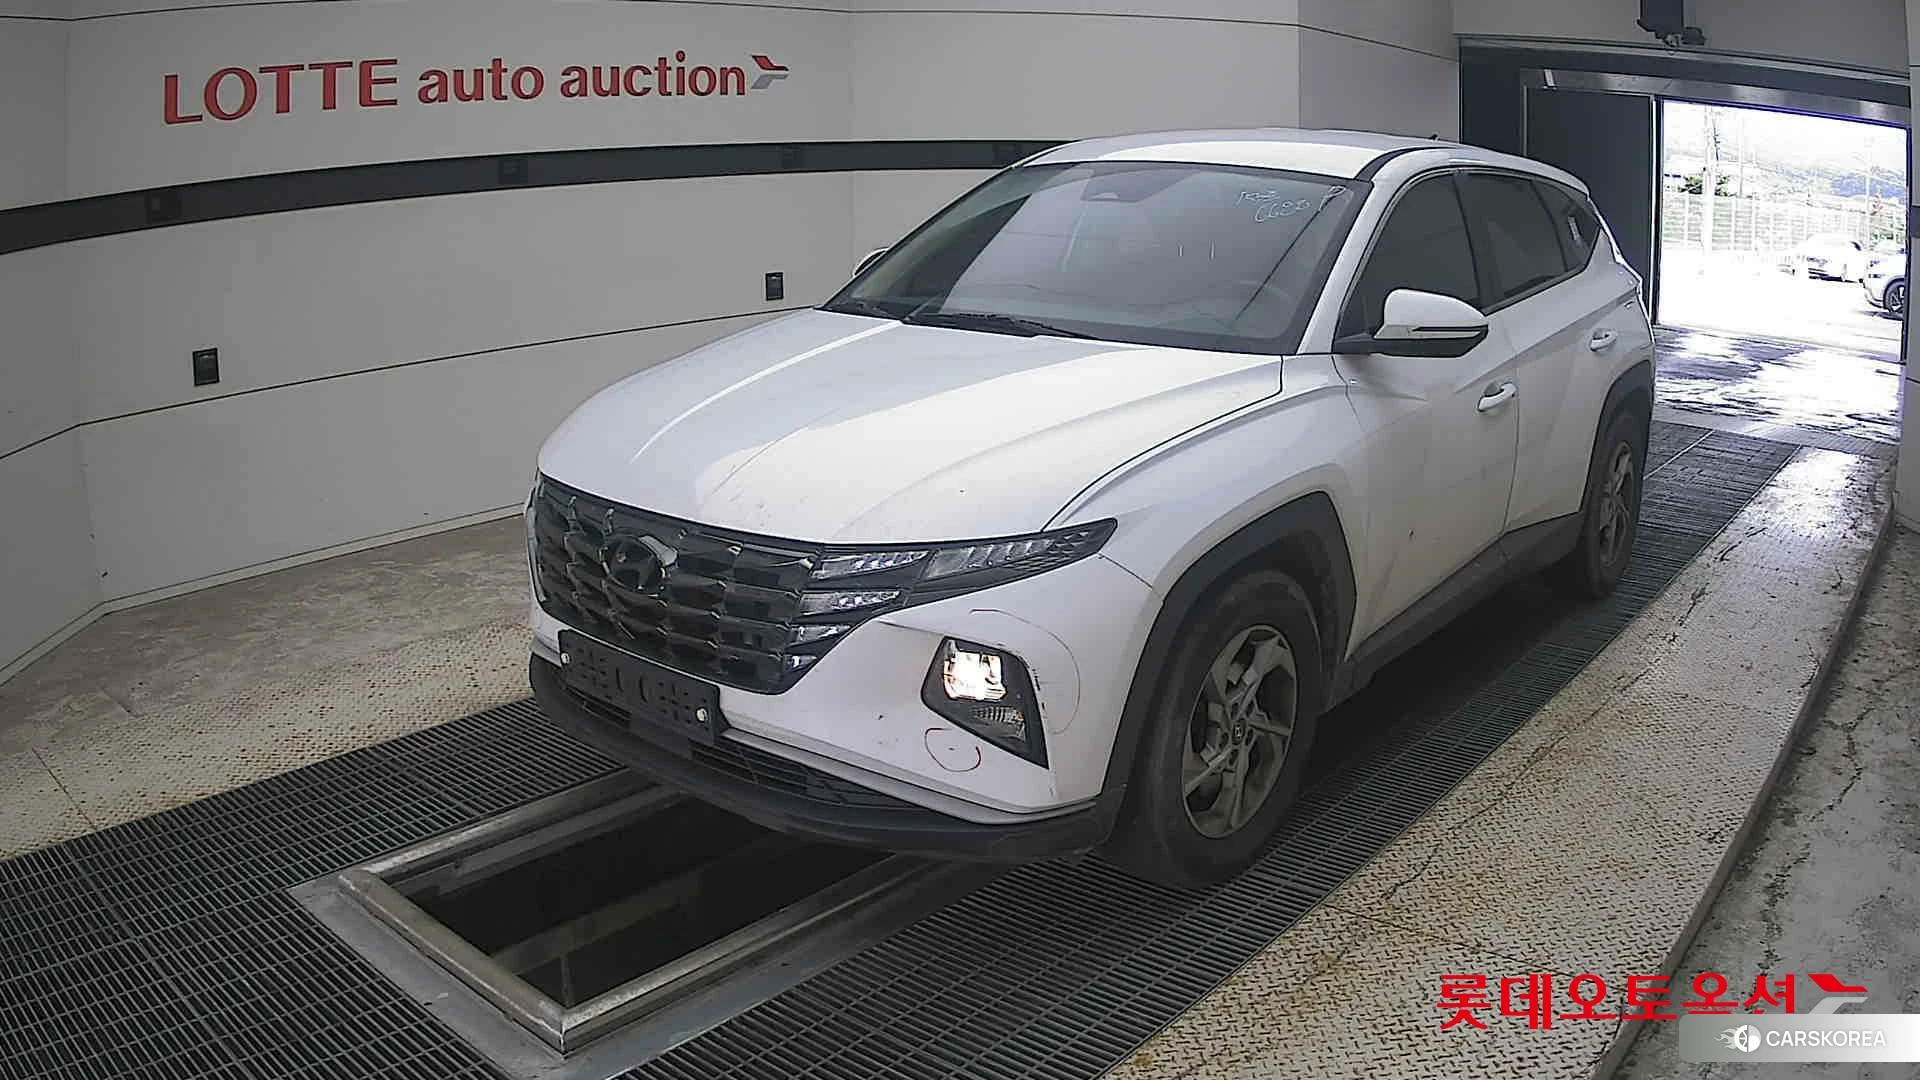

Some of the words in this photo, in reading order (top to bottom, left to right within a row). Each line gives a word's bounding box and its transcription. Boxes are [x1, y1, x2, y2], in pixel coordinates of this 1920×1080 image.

[163, 58, 398, 125] LOTTE
[417, 58, 544, 104] auto
[560, 51, 747, 98] auction
